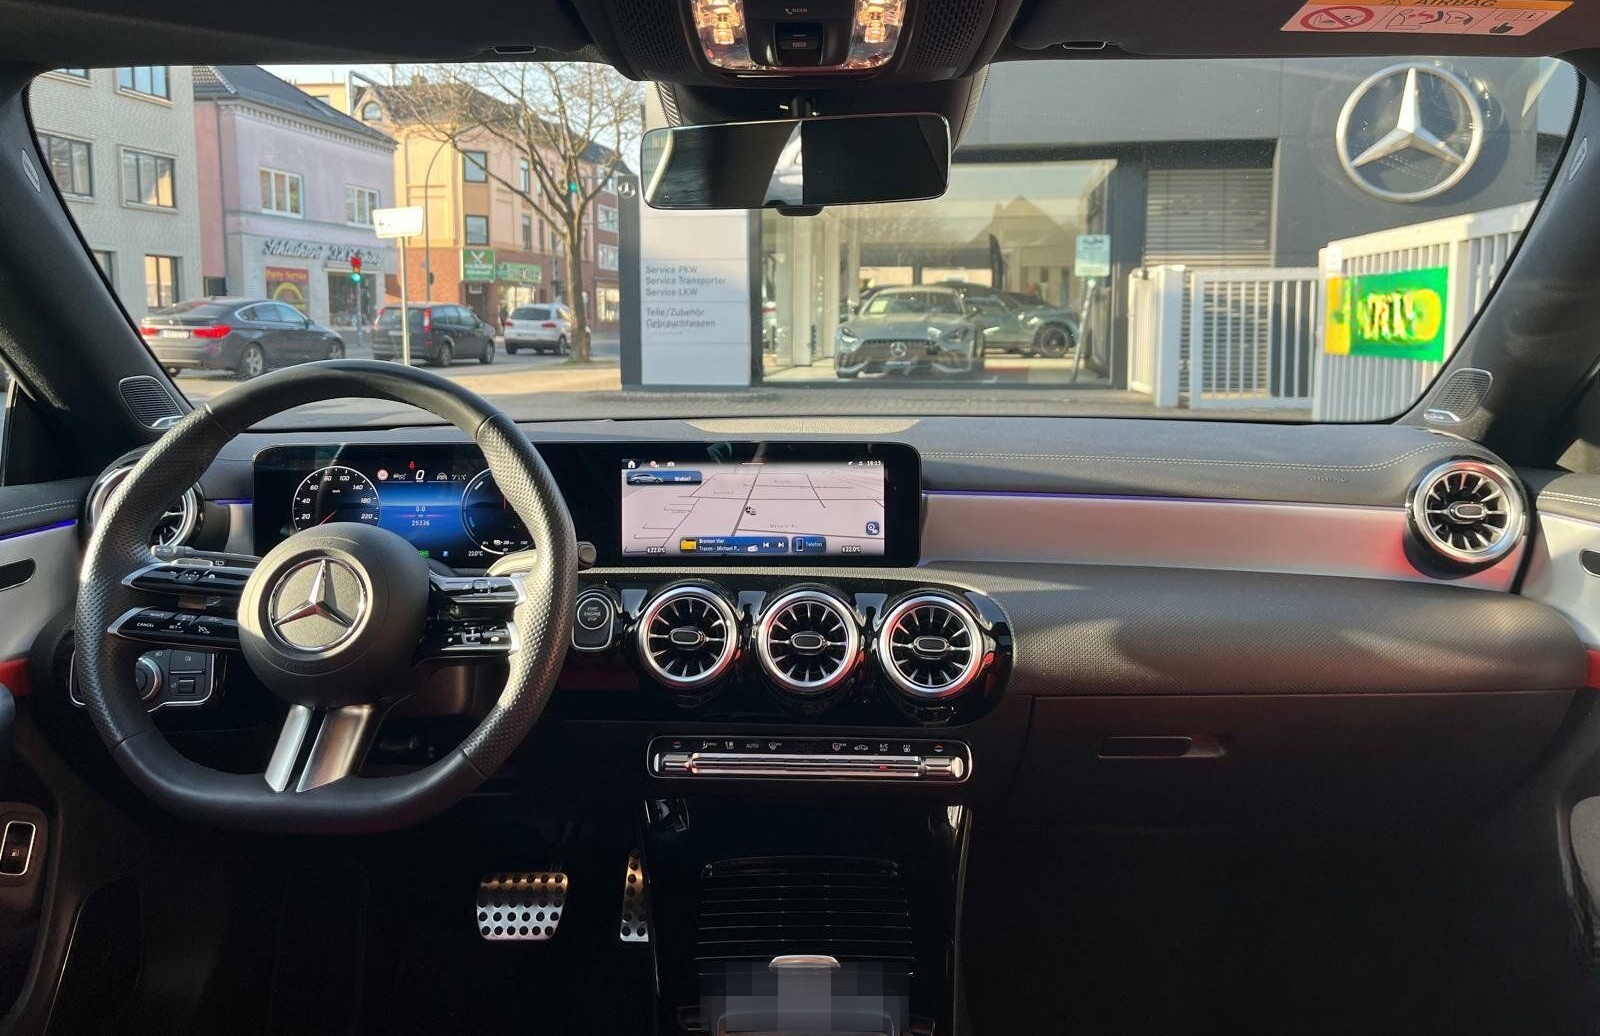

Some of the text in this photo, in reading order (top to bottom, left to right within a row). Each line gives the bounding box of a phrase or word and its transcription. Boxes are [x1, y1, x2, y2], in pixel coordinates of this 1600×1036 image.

[646, 266, 677, 274] Service
[646, 276, 727, 287] Service Transporter
[646, 288, 698, 296] Service LKW
[647, 307, 705, 318] Teile/Zubehör
[415, 469, 425, 480] 0
